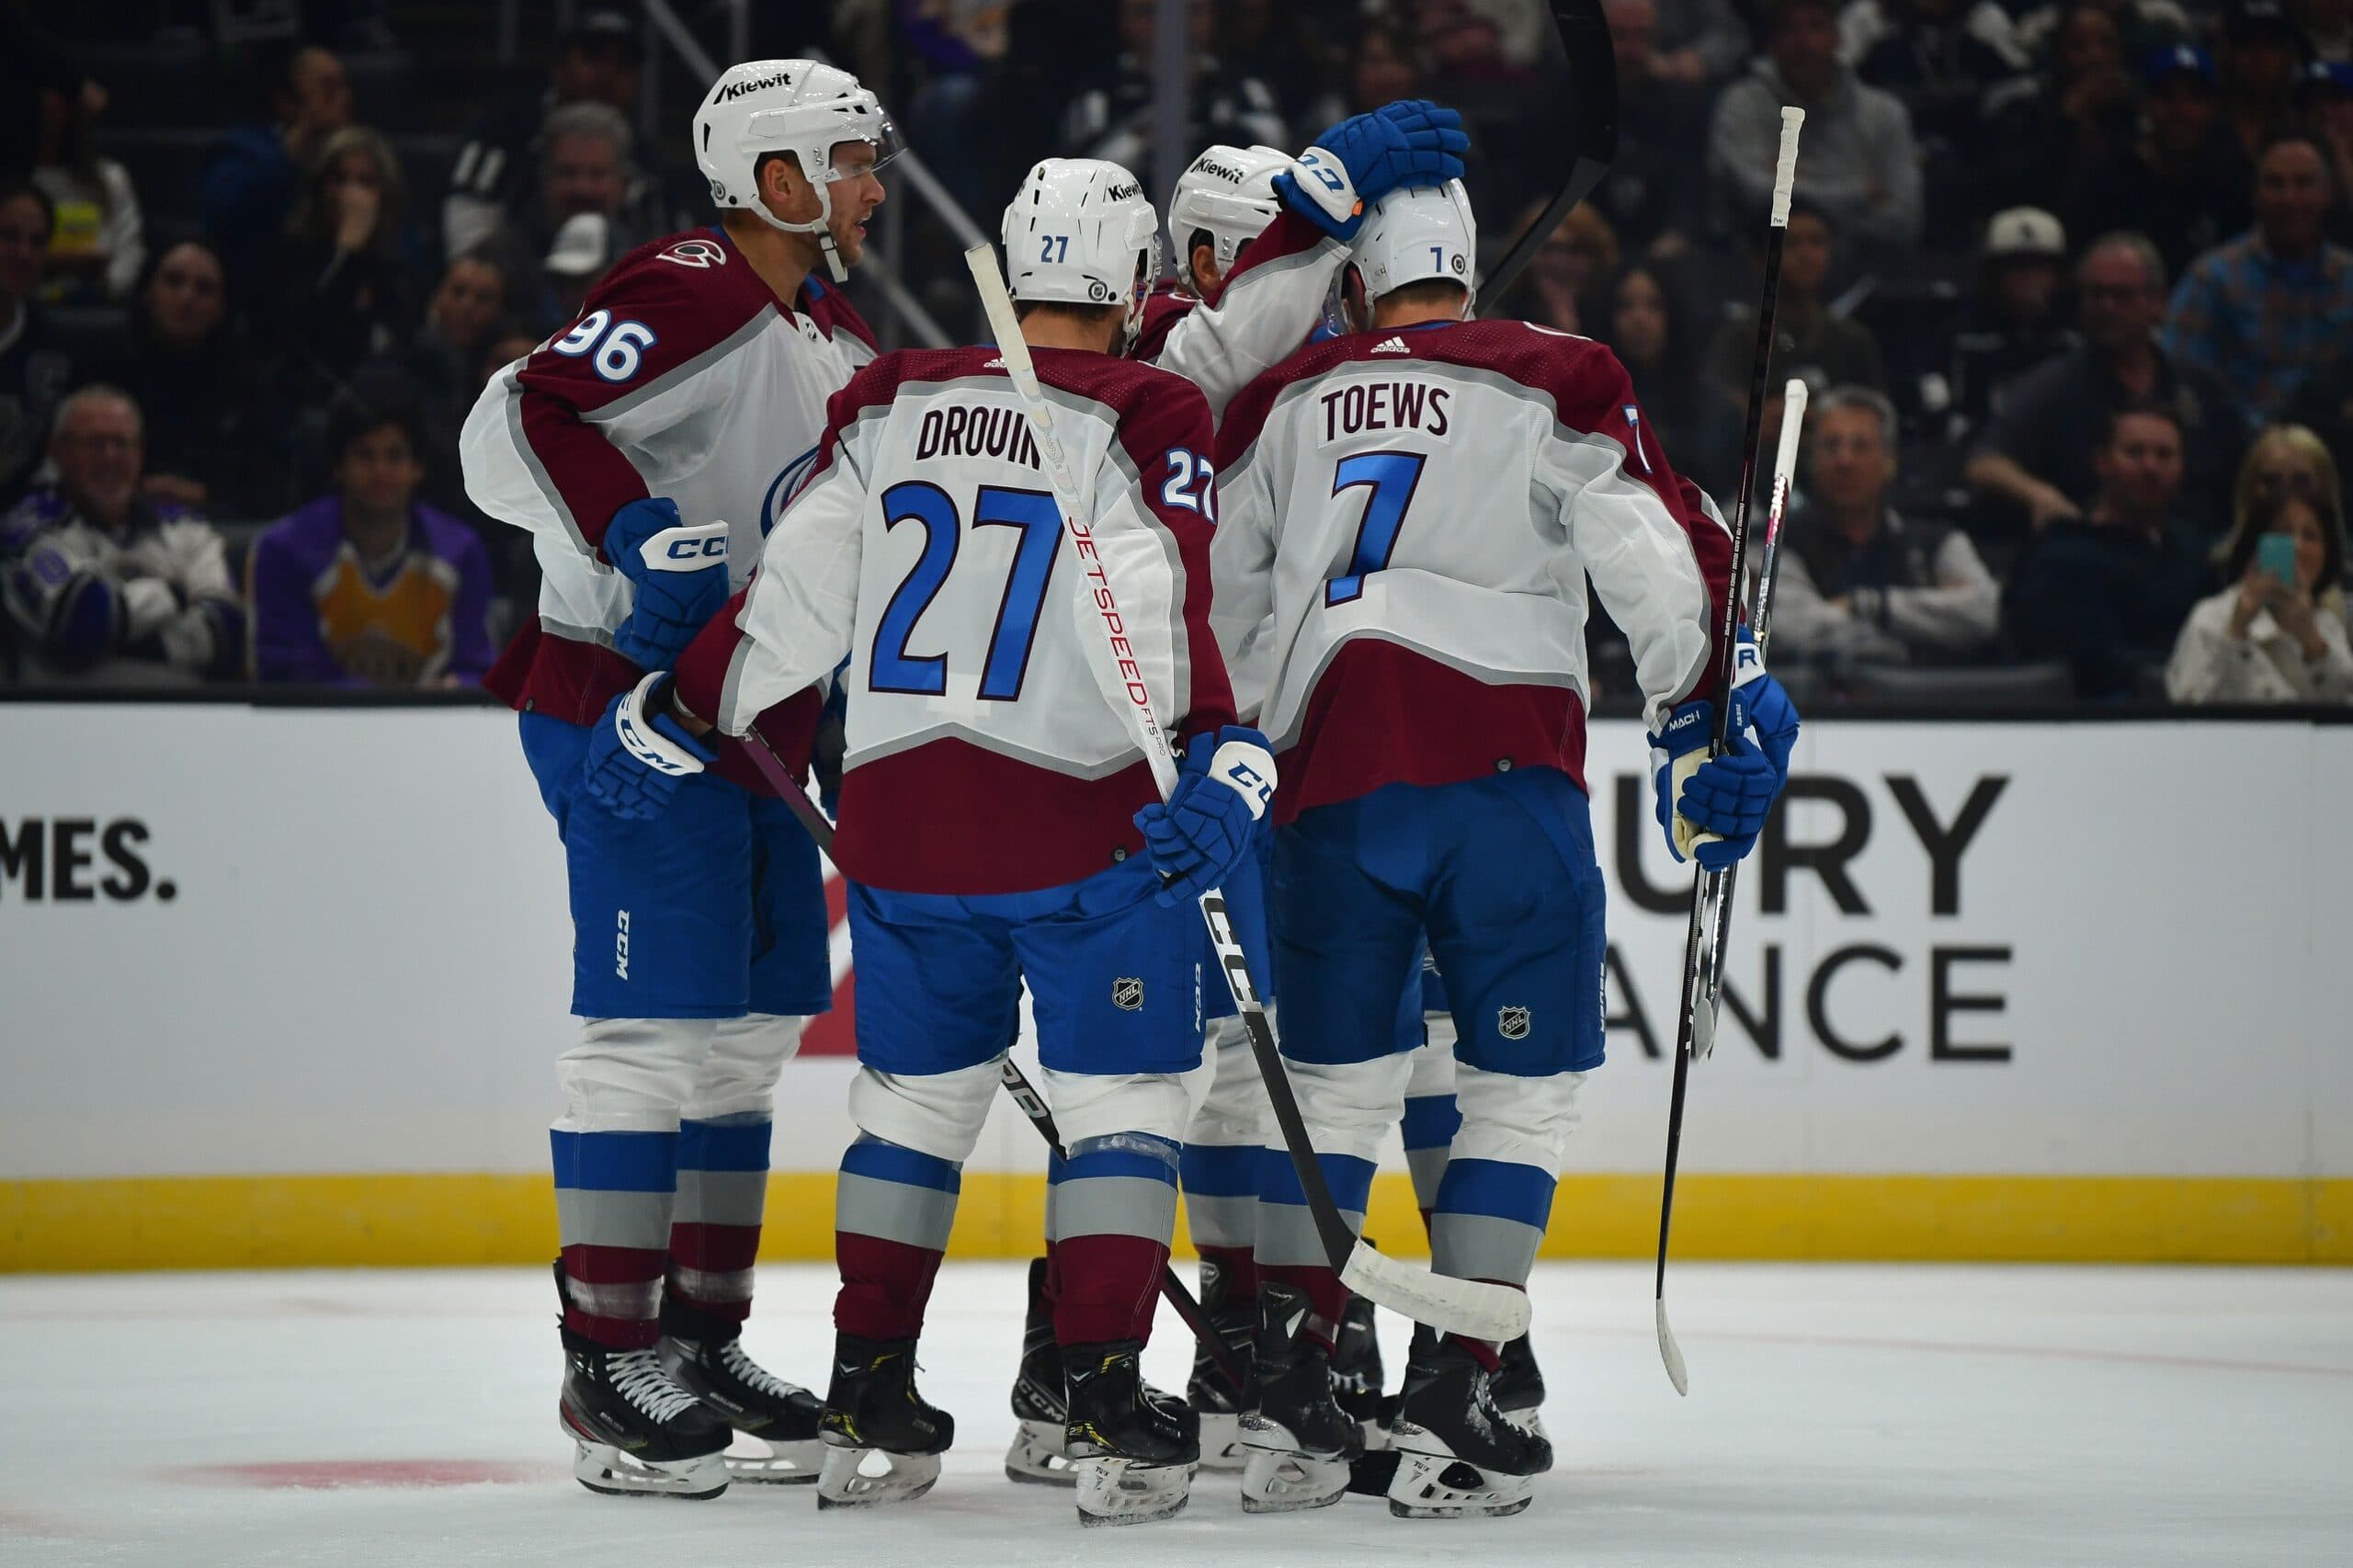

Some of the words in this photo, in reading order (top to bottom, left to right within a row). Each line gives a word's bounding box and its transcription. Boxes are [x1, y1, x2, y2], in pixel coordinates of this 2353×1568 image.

[724, 73, 791, 101] Kiewit
[1196, 157, 1245, 185] Kiewit
[1040, 235, 1069, 264] 27
[551, 309, 658, 384] 96
[915, 405, 1041, 472] DROUIN
[1321, 382, 1450, 442] TOEWS
[1162, 445, 1218, 525] 27
[666, 535, 729, 560] CC
[1324, 449, 1427, 608] 7
[868, 479, 1066, 702] 27
[1068, 516, 1148, 706] JETSPEED
[1141, 707, 1159, 736] FTS
[1668, 710, 1700, 733] MACH
[0, 817, 176, 901] MES.
[616, 909, 630, 982] CCM
[1017, 1380, 1065, 1422] CCM
